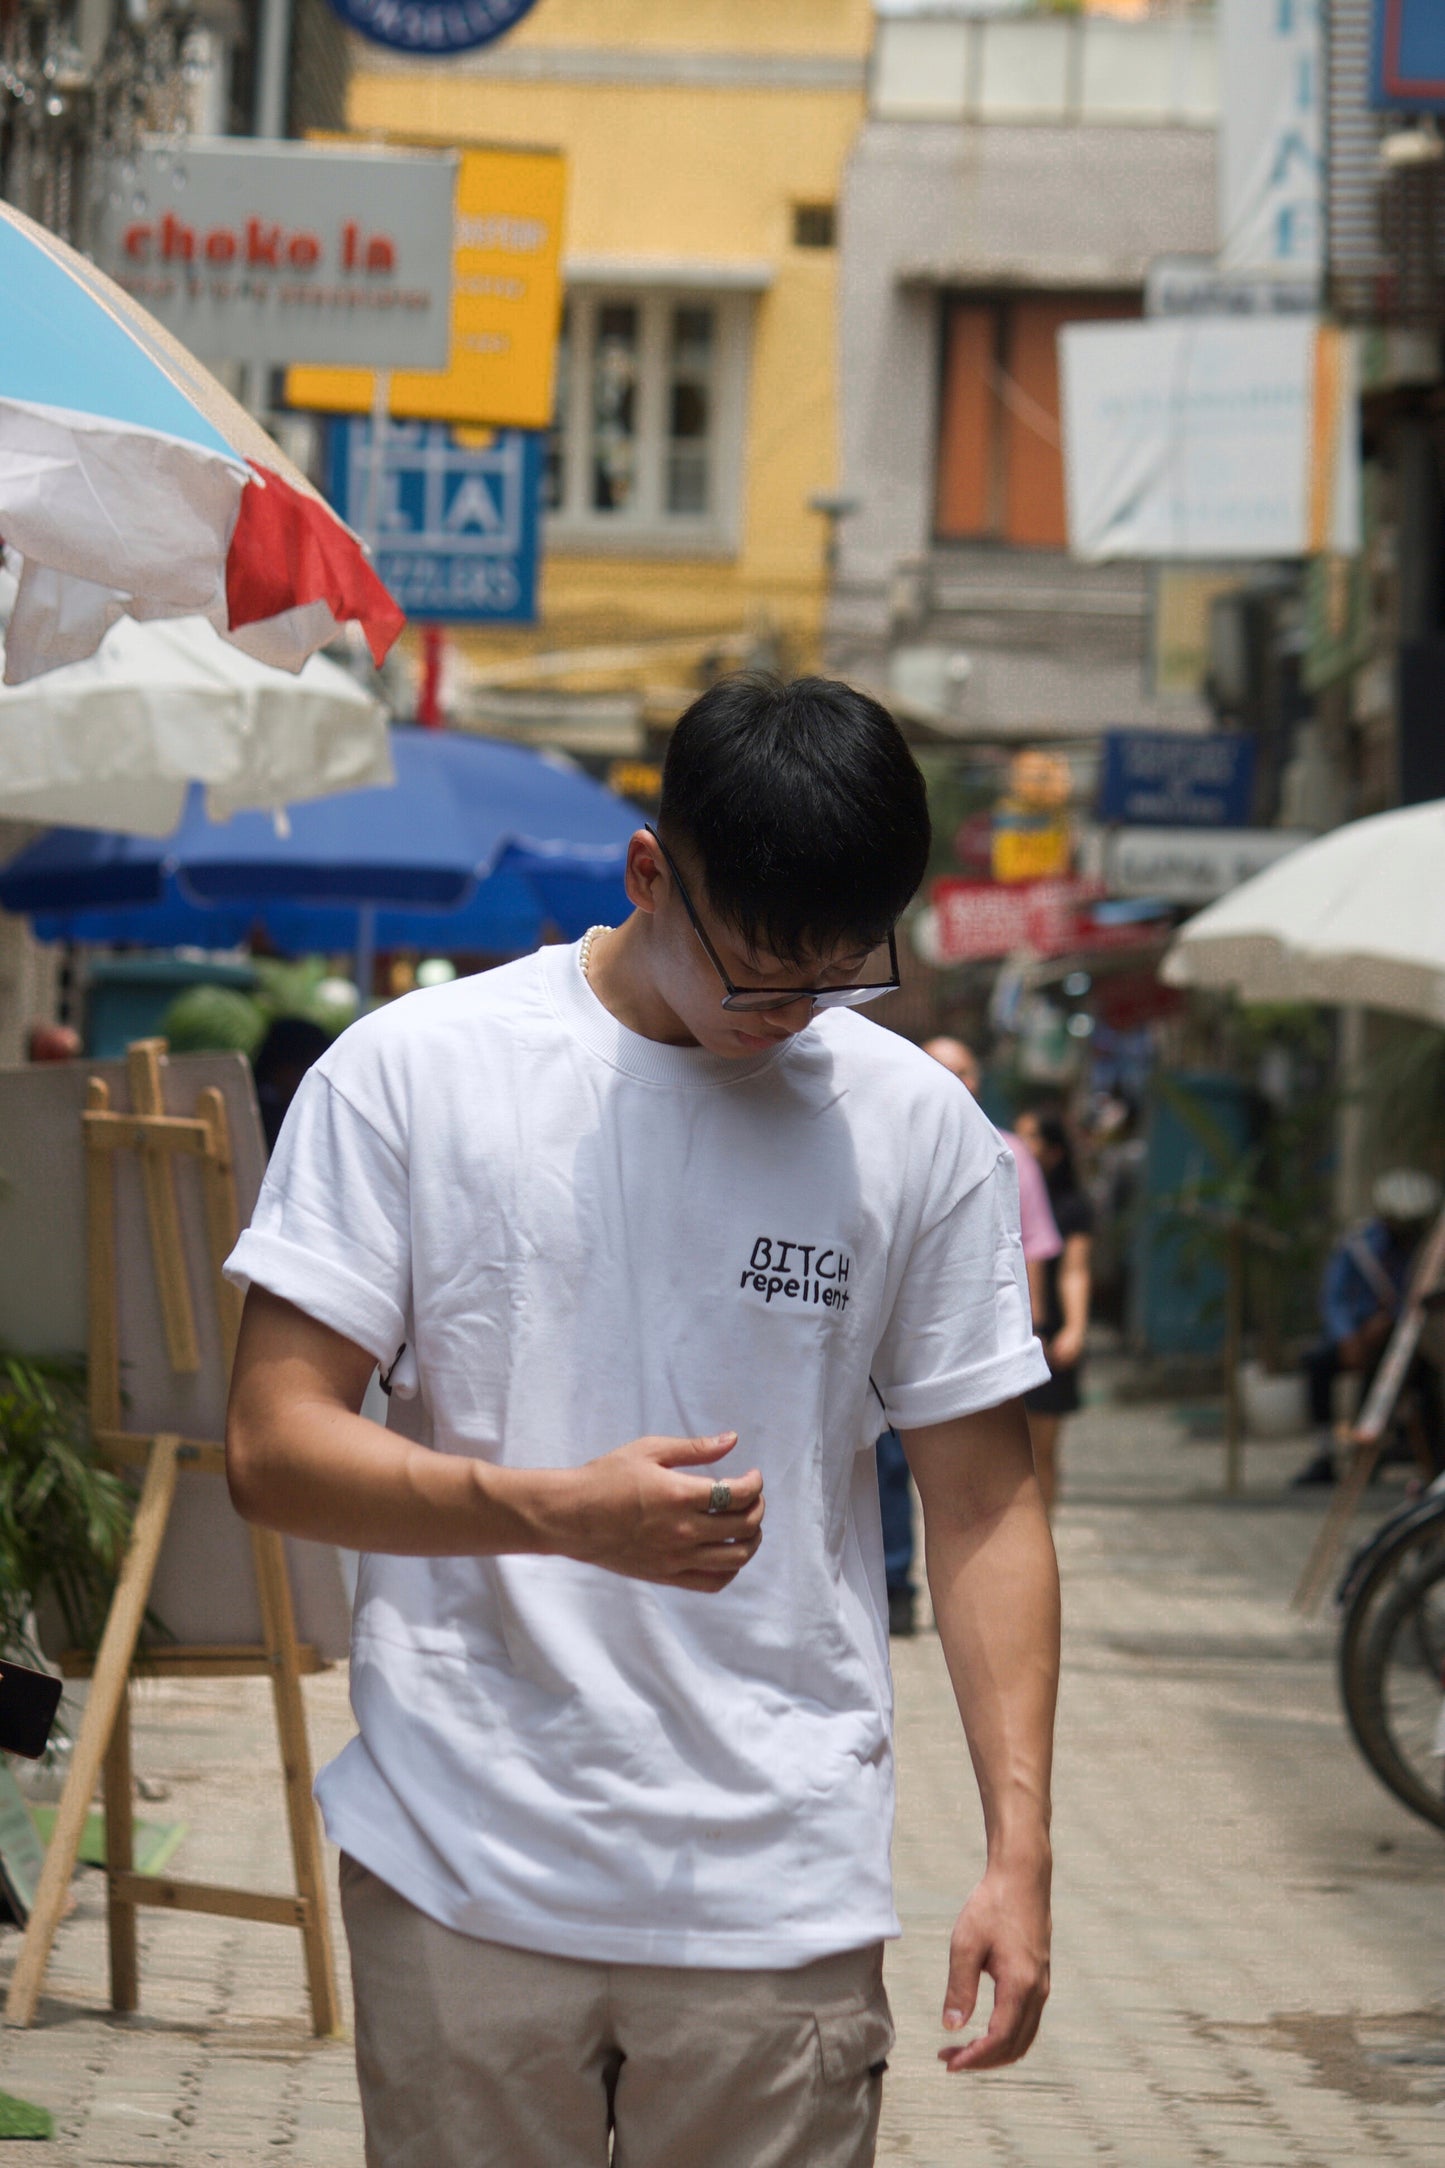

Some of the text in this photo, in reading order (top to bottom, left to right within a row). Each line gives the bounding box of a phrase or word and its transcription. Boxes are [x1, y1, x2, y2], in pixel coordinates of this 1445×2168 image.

[123, 209, 320, 267] choko
[341, 217, 395, 275] la
[750, 1237, 849, 1282] BITCH
[740, 1271, 849, 1311] repellent
